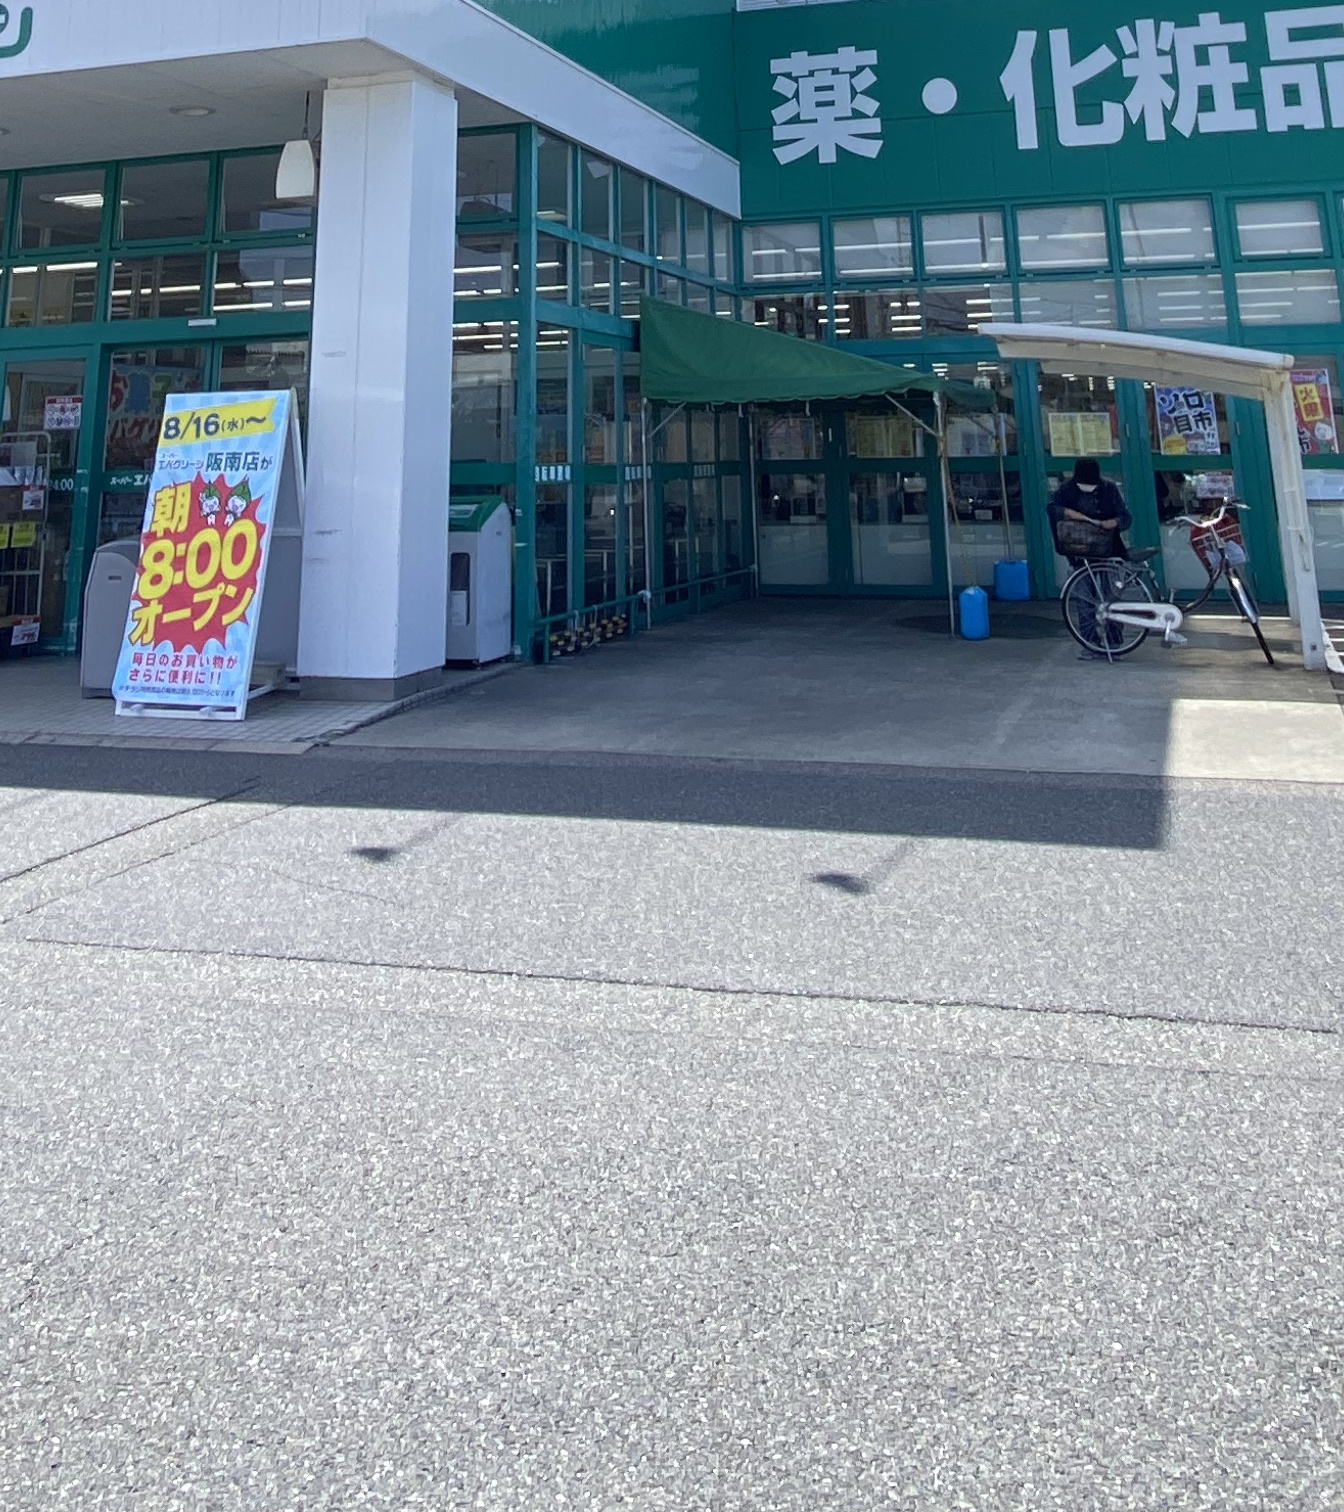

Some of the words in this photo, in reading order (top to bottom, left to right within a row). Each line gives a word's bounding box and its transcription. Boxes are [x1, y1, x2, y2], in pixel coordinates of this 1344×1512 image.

[150, 481, 192, 538] 朝
[137, 518, 258, 600] 8:00
[128, 581, 255, 646] オープン
[132, 652, 238, 670] 毎日のお買い物が
